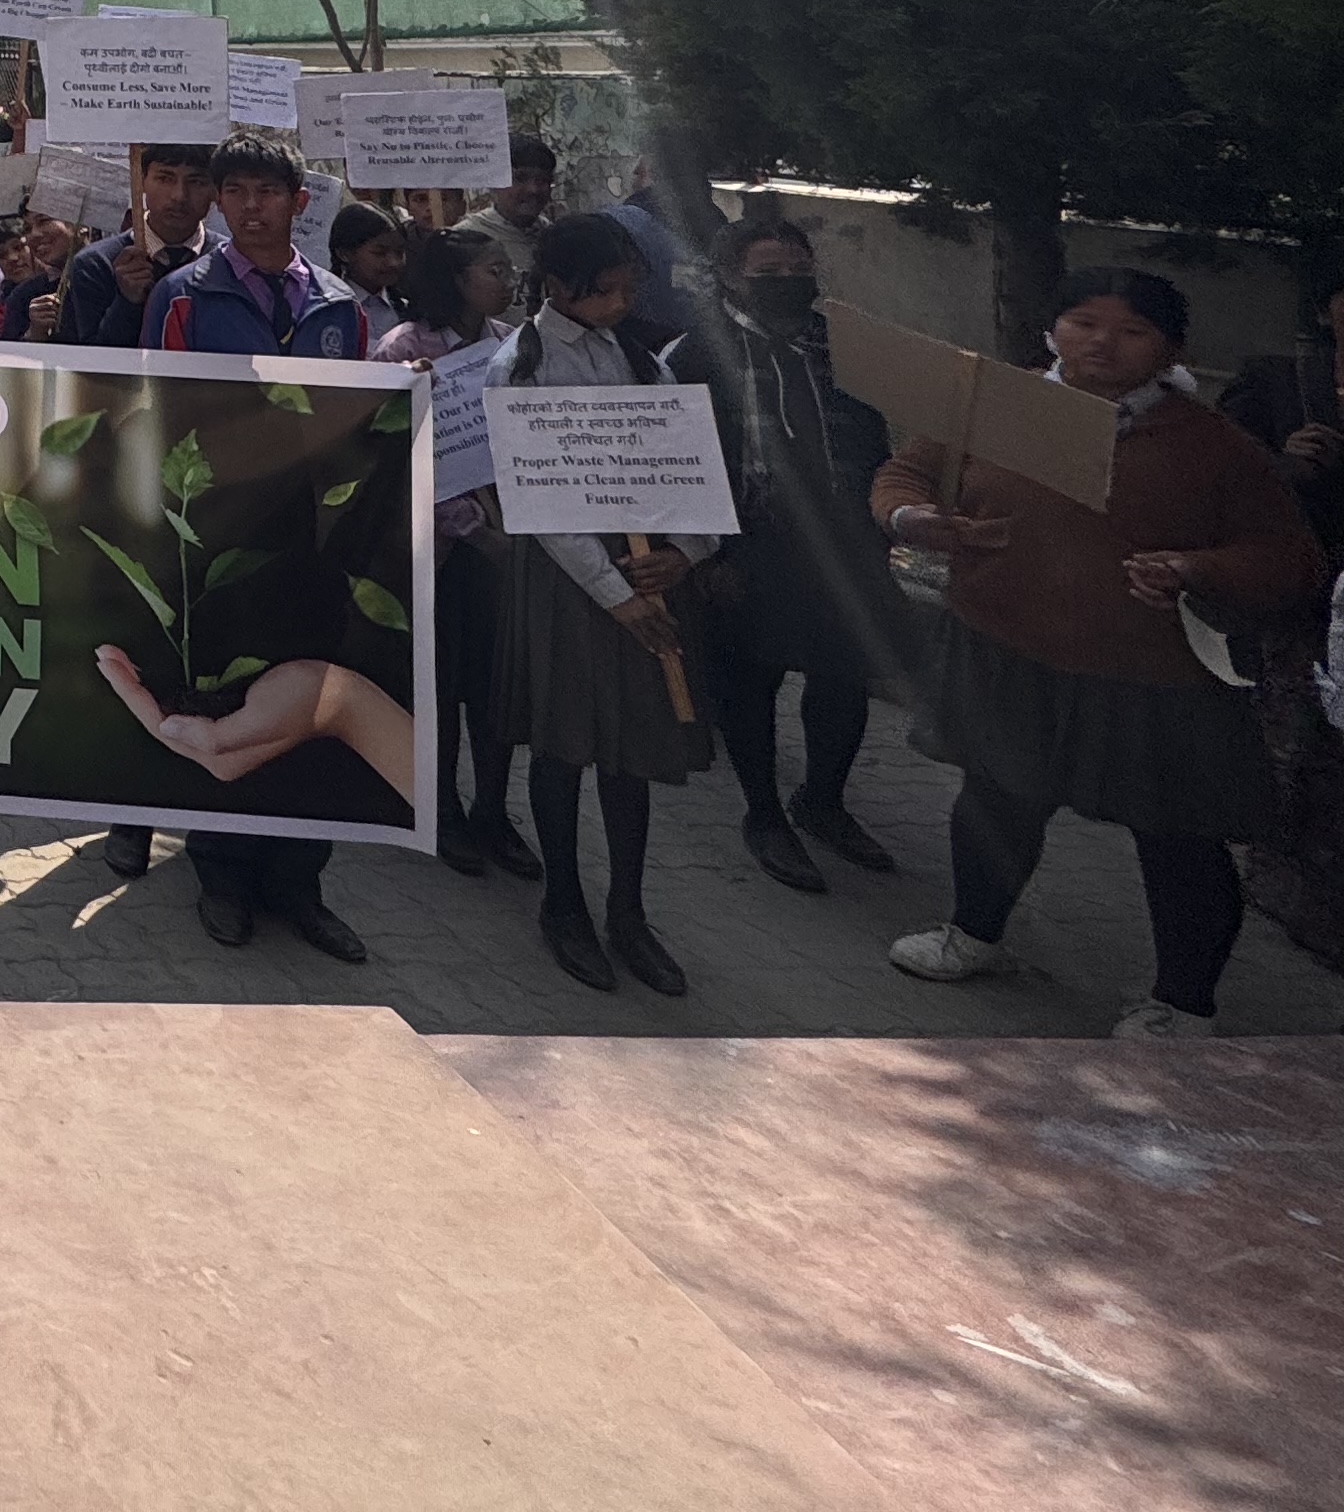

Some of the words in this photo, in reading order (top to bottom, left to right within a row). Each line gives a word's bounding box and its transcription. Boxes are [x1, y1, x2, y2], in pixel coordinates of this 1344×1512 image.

[62, 80, 116, 92] Consume
[120, 81, 149, 93] Less,
[150, 82, 177, 93] Save
[179, 82, 212, 93] More
[71, 98, 104, 109] Make
[107, 99, 140, 110] Earth
[143, 99, 213, 111] Sustainable!
[360, 142, 378, 152] Say
[381, 142, 397, 151] No
[455, 140, 497, 150] Choose
[368, 155, 416, 165] Reusable
[439, 407, 461, 419] Our
[507, 399, 553, 415] फोहोरको
[555, 399, 587, 414] उचित
[591, 400, 656, 415] व्यवस्थापन
[462, 421, 473, 430] is
[528, 417, 573, 431] हरियाली
[575, 419, 584, 429] र
[587, 419, 623, 431] स्वच्छ
[627, 417, 668, 431] भविष्य
[513, 455, 558, 469] Proper
[562, 454, 604, 467] Waste
[608, 455, 701, 469] Management
[516, 474, 569, 487] Ensures
[572, 477, 580, 486] a
[584, 473, 626, 486] Clean
[629, 474, 656, 486] and
[660, 474, 705, 487] Green
[585, 492, 639, 505] Future.
